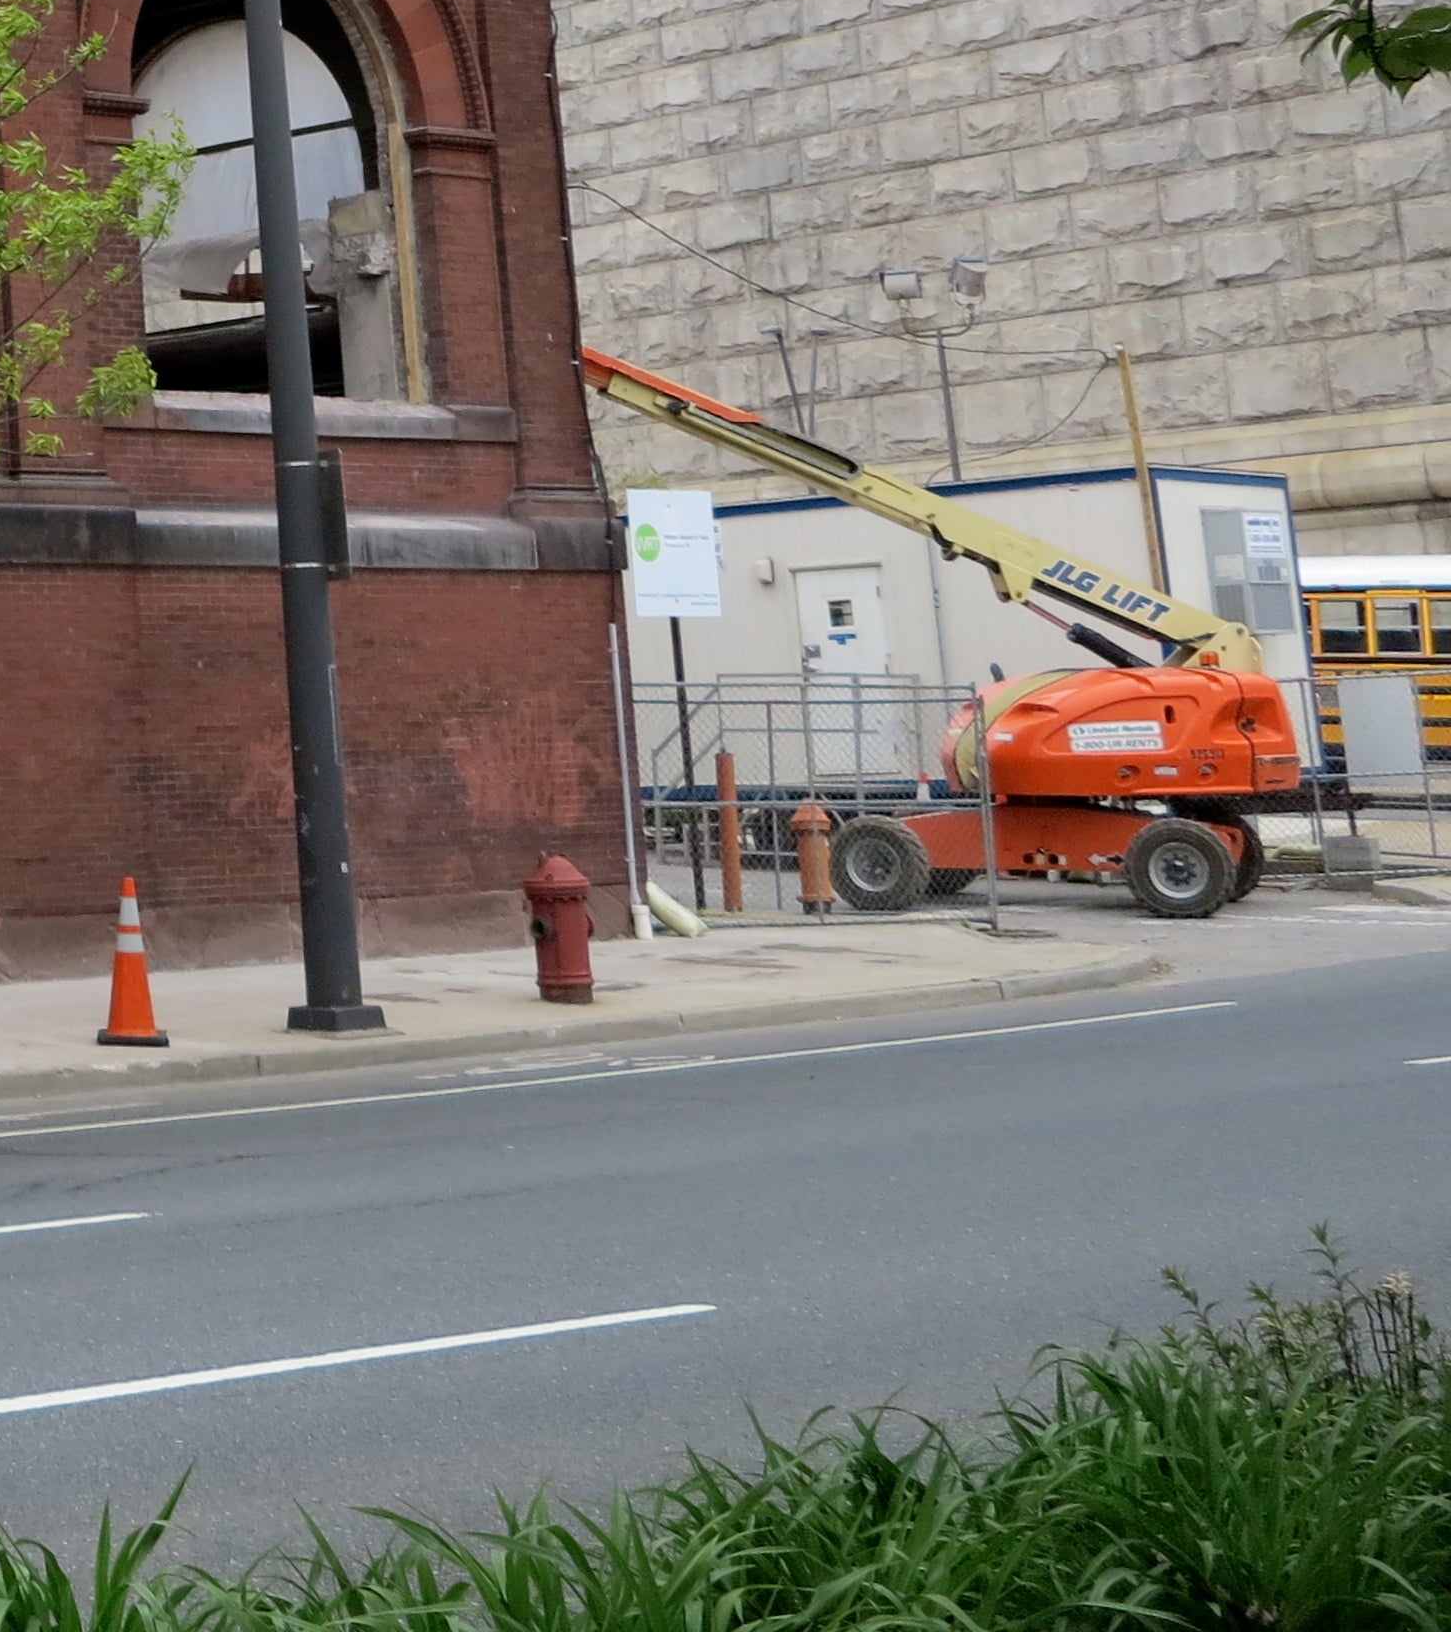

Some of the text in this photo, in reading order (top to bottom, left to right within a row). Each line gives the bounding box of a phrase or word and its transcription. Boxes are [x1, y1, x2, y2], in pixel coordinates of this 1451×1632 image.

[1040, 559, 1171, 623] JLG LIFT
[1087, 723, 1155, 734] United Rentals
